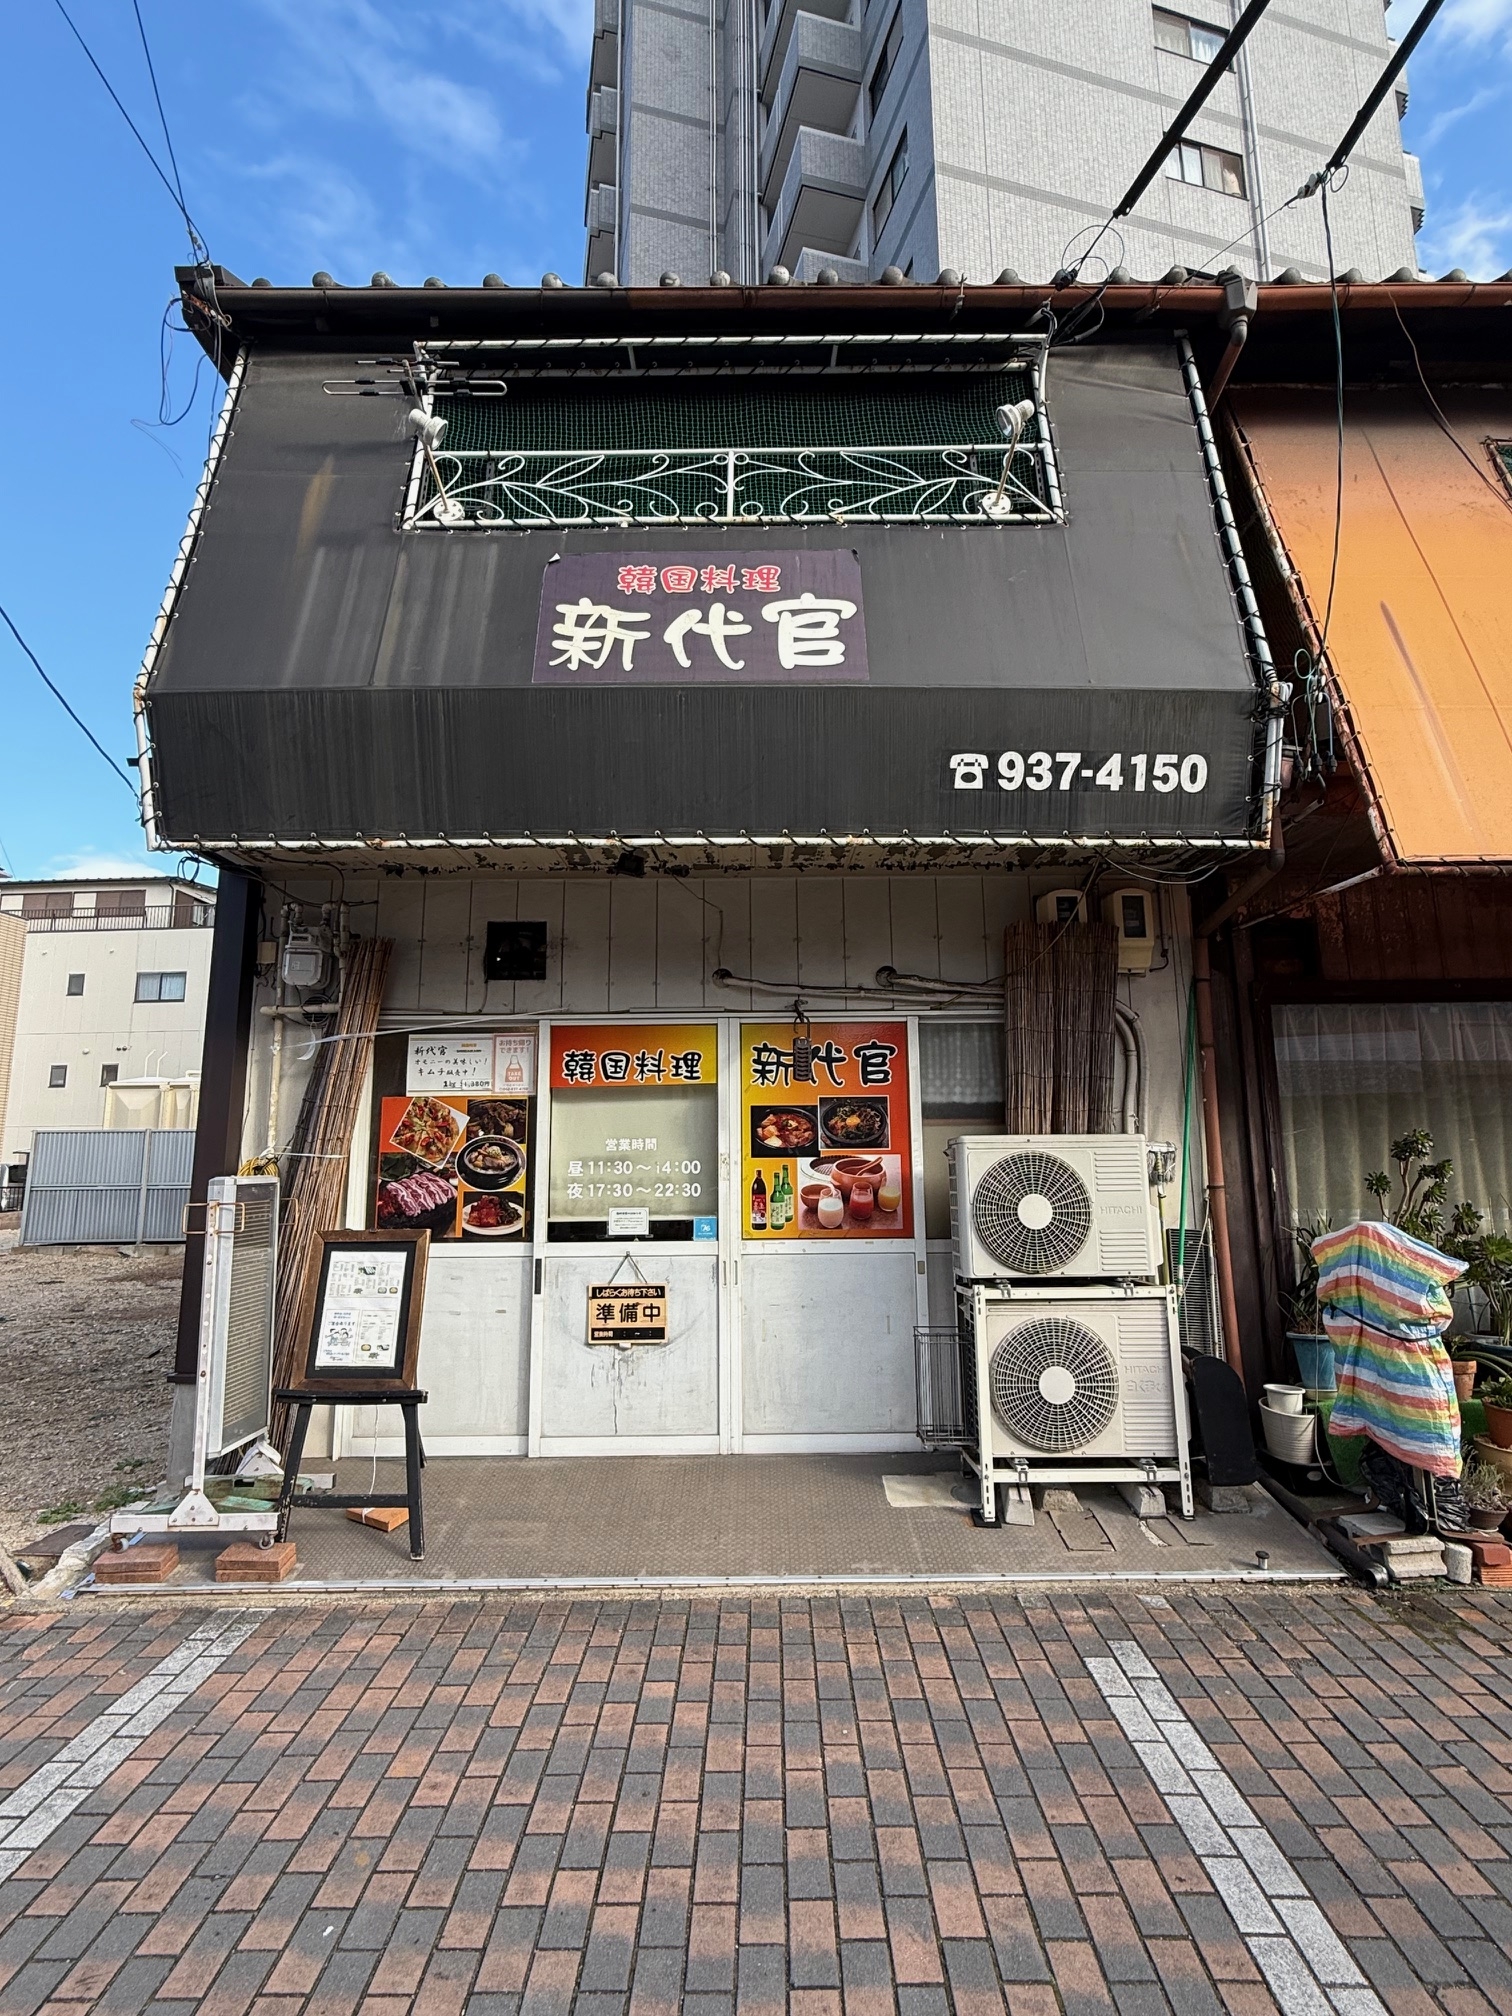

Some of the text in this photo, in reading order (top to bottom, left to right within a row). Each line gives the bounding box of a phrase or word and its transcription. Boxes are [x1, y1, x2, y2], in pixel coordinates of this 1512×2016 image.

[617, 564, 781, 595] 韓国料理
[549, 593, 857, 671] 新代官
[998, 751, 1208, 793] 937-4150
[415, 1045, 448, 1056] 新代官
[752, 1039, 898, 1087] 新代官
[562, 1049, 702, 1083] 韓国料理
[605, 1138, 658, 1151] 営業時間
[1100, 1206, 1142, 1214] HITACHI
[596, 1288, 661, 1297] しばらくお待ち下さい
[596, 1303, 661, 1323] 準備中
